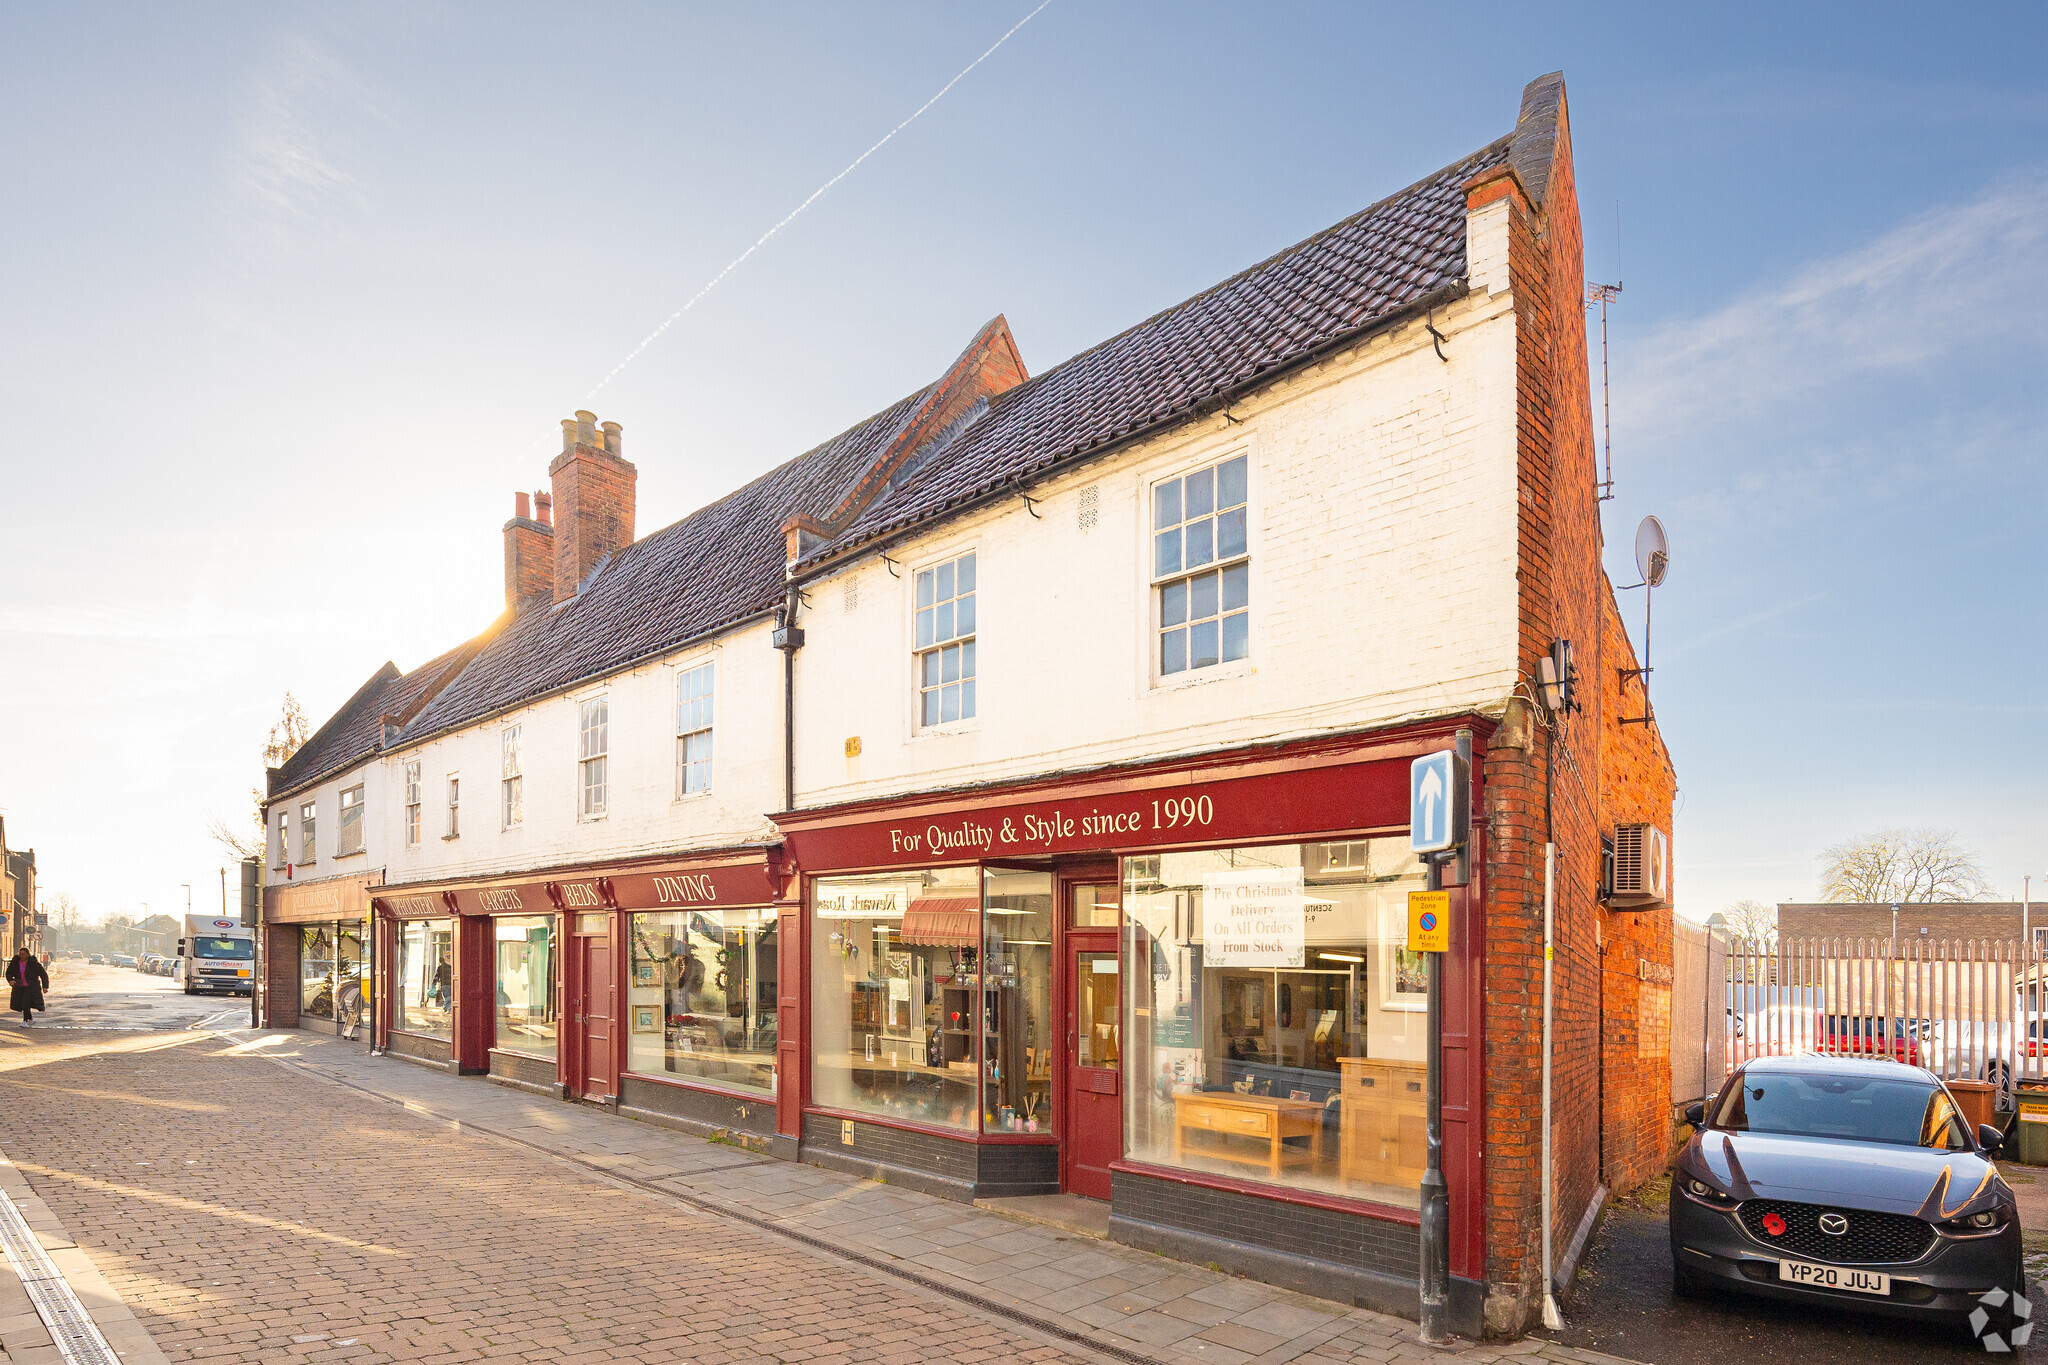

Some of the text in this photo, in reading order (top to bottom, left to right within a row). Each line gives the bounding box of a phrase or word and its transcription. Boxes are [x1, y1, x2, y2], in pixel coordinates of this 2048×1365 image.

[890, 794, 1214, 855] For Quality & Style since 1990
[562, 883, 599, 906] BEDS
[653, 874, 717, 903] DINING
[1214, 885, 1293, 900] Pre Christmas
[388, 896, 437, 916] UPHOLSTERY
[478, 889, 523, 911] CARPETS
[1231, 905, 1275, 918] Delivery
[1214, 920, 1293, 935] On All Orders
[1223, 939, 1284, 953] From Stock
[1788, 1263, 1882, 1291] YP20 JUJ
